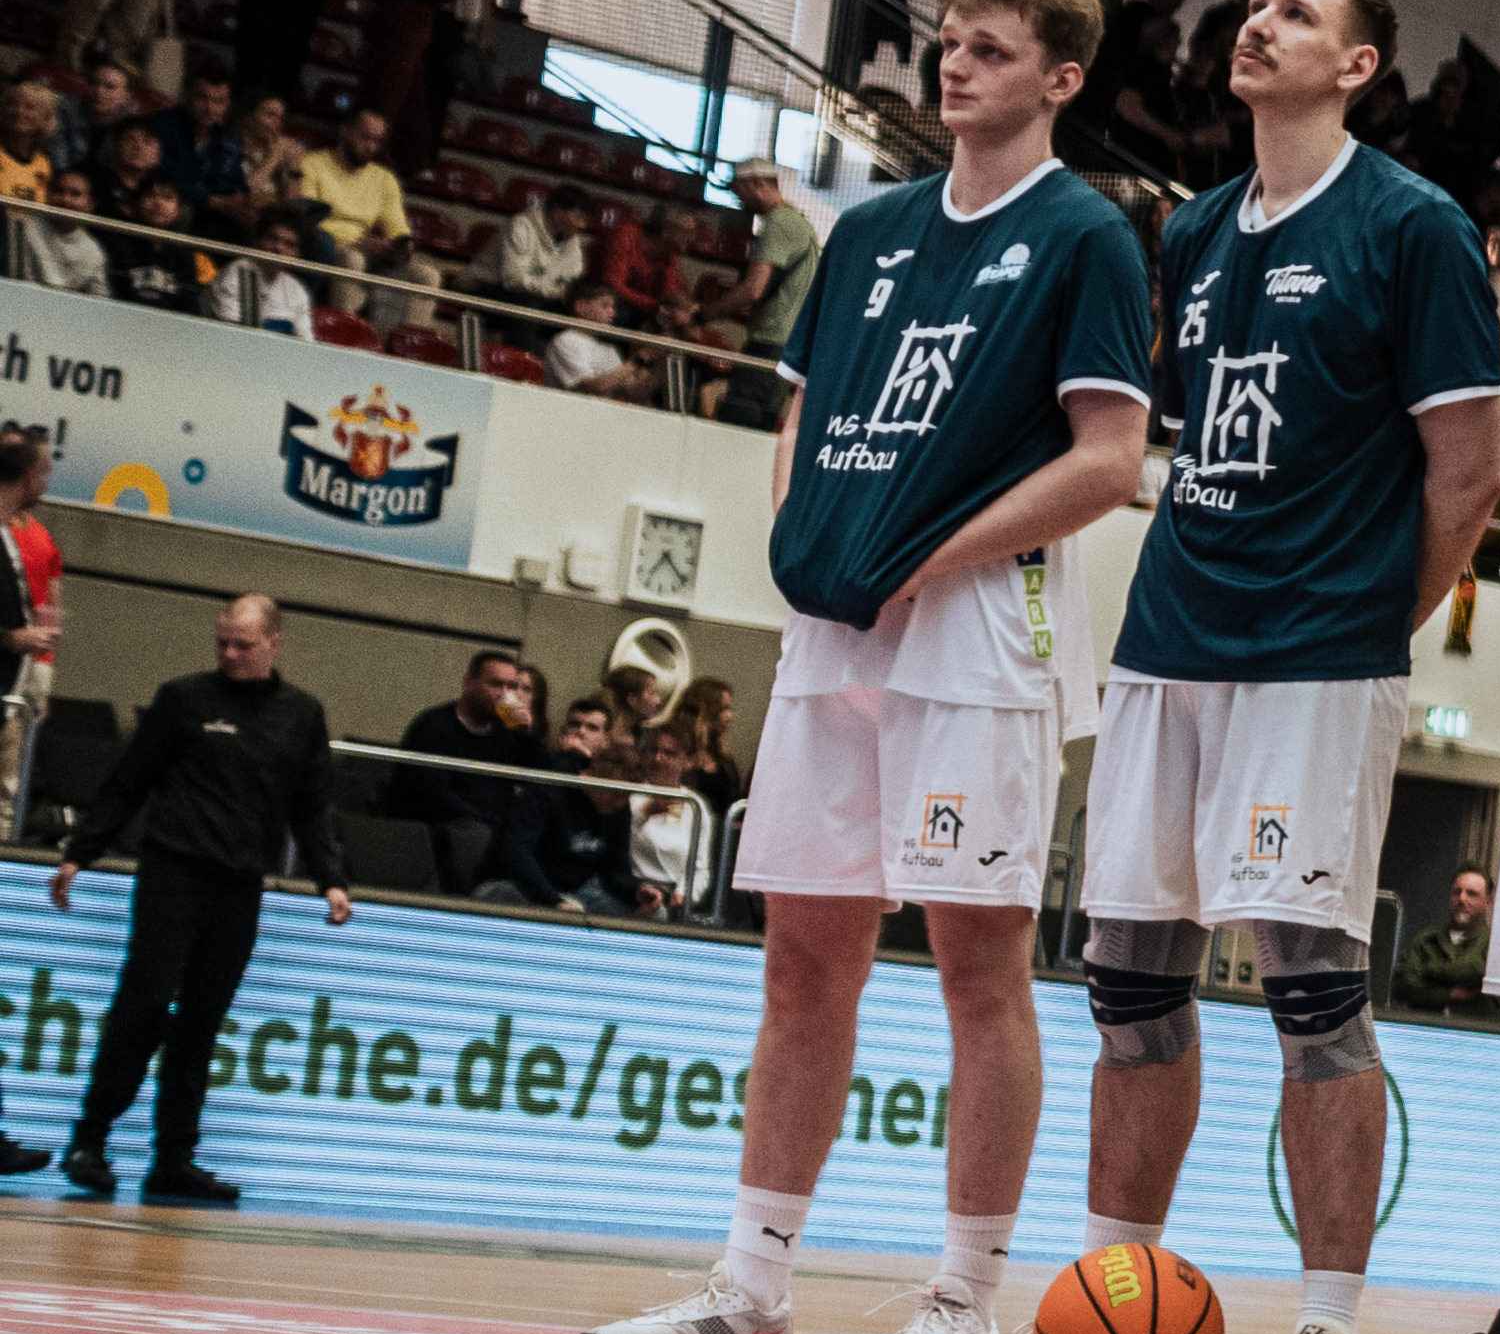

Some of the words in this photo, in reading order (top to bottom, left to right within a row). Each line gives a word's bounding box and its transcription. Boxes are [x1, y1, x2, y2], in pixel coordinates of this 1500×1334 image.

[864, 278, 895, 318] 9
[1179, 299, 1210, 349] 25
[48, 354, 124, 401] von
[816, 443, 897, 472] Aufbau
[300, 456, 428, 527] Margon
